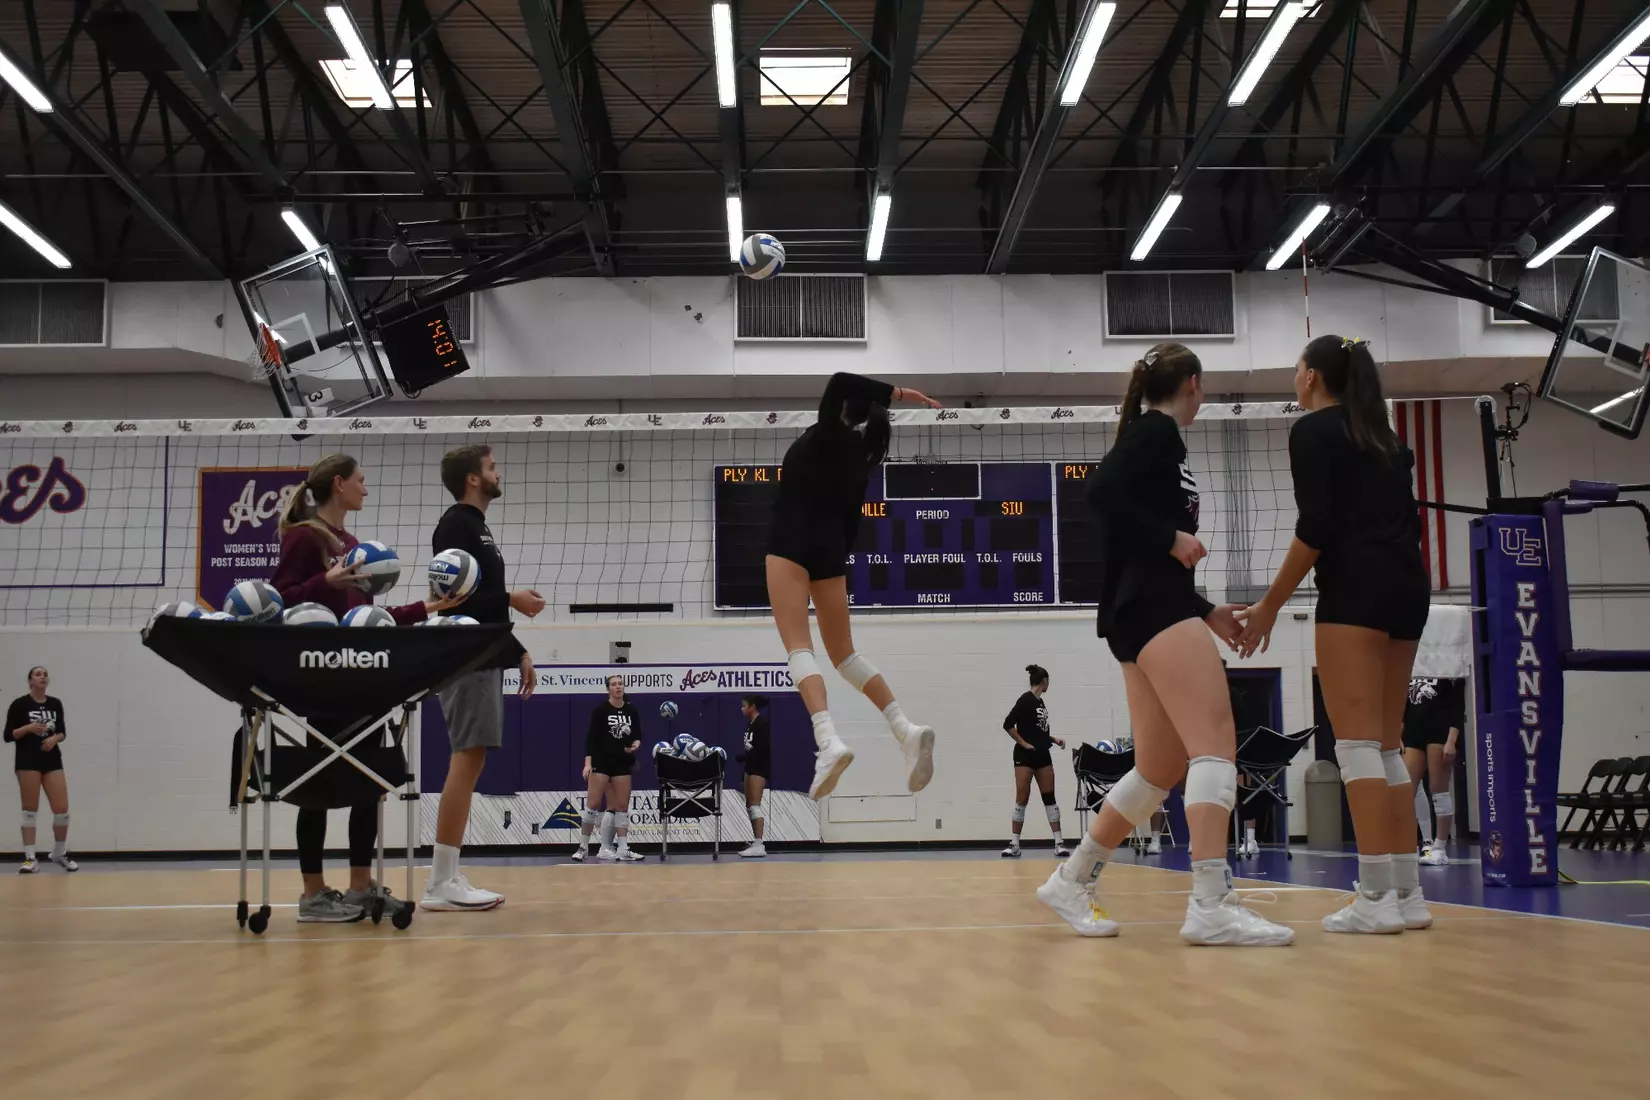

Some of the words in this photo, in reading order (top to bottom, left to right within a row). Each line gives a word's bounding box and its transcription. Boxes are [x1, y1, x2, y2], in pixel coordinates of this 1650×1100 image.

[702, 413, 726, 425] Aces
[935, 409, 959, 421] Aces
[1051, 407, 1074, 419] Aces
[114, 421, 137, 433] Aces
[232, 419, 256, 432] Aces
[349, 418, 372, 430] Aces
[468, 416, 491, 429] Aces
[584, 415, 608, 427] Aces
[724, 468, 747, 482] PLY
[754, 468, 770, 482] KL
[1065, 465, 1088, 479] PLY
[1001, 501, 1023, 515] SIU
[916, 509, 950, 520] PERIOD
[224, 543, 264, 554] WOMEN'S
[1499, 527, 1541, 566] UE
[211, 557, 232, 567] POST
[235, 557, 267, 567] SEASON
[867, 554, 893, 564] T.O.L.
[903, 553, 940, 564] PLAYER
[942, 553, 966, 563] FOUL
[976, 553, 1002, 563] T.O.L.
[1012, 552, 1043, 562] FOULS
[917, 593, 951, 603] MATCH
[1013, 592, 1044, 602] SCORE
[299, 648, 389, 669] molten
[541, 674, 558, 686] St.
[617, 674, 673, 687] UPPORTS
[679, 669, 717, 691] Aces
[717, 670, 794, 688] ATHLETICS
[28, 710, 57, 722] SIU
[608, 714, 632, 726] SIU
[1515, 581, 1550, 876] EVANSVILLE
[1484, 732, 1495, 772] sports
[1487, 774, 1497, 823] imports
